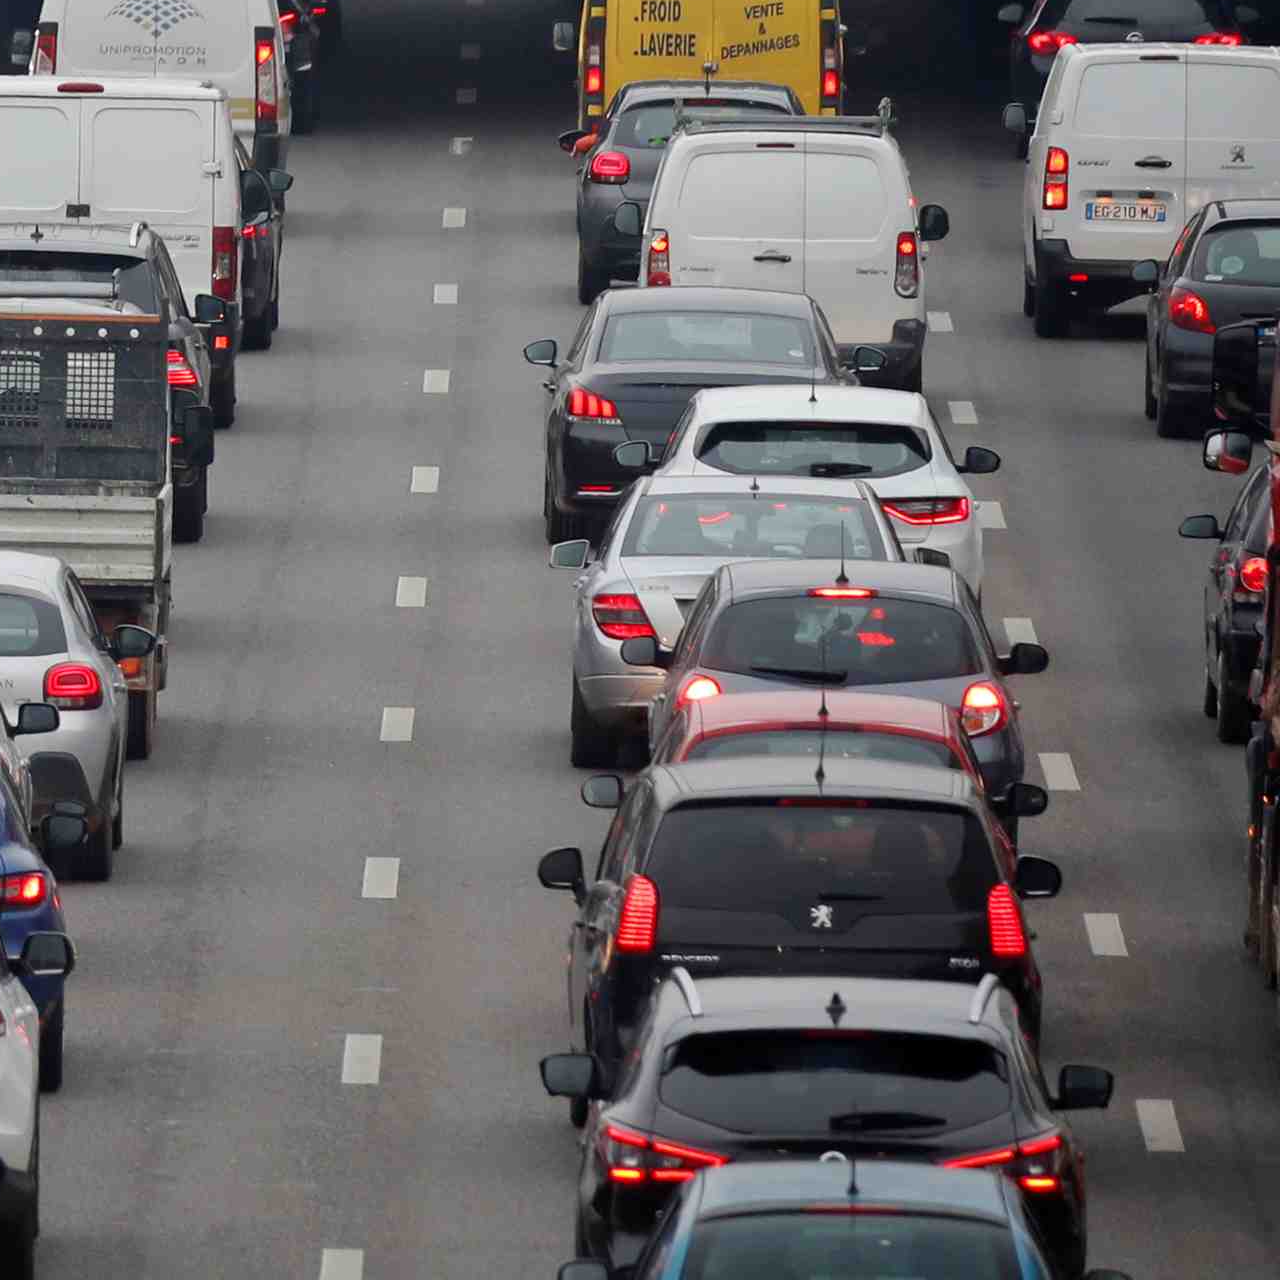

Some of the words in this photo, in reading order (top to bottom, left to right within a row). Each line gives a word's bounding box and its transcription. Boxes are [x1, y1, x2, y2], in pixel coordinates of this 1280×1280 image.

[744, 2, 784, 19] VENTE
[758, 23, 766, 35] &
[99, 45, 206, 56] UNIPROMOTION
[721, 34, 800, 60] DEPANNAGES
